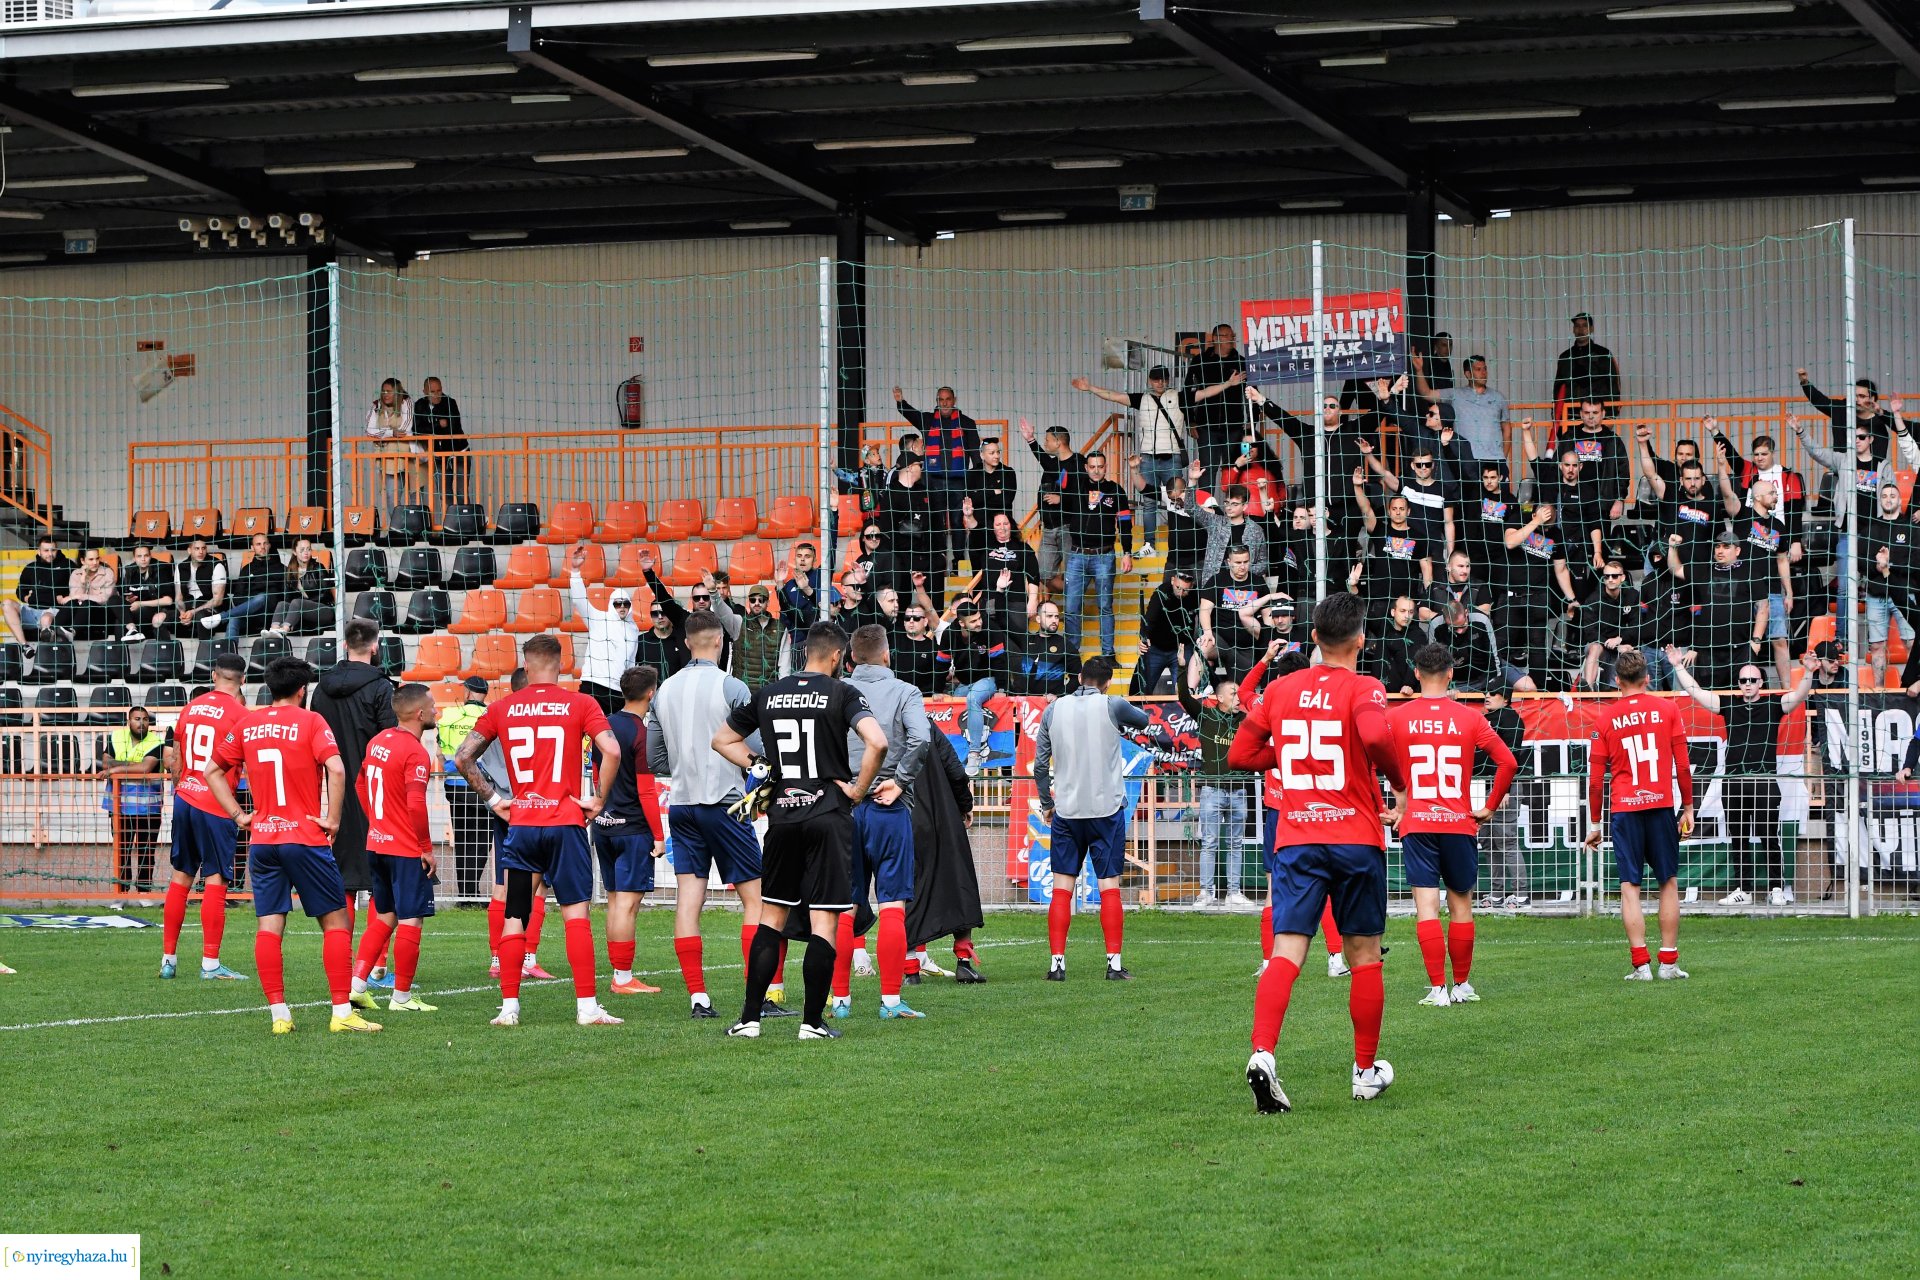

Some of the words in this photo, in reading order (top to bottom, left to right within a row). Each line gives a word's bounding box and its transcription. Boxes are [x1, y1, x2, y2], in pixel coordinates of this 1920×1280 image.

[1249, 354, 1396, 373] NYÍREYHÁZA
[188, 704, 225, 720] BRESÓ
[507, 702, 571, 718] ADAMCSEK
[766, 691, 829, 710] HEGEDÜS
[1298, 688, 1333, 710] GÁL
[1611, 711, 1647, 731] NAGY
[1651, 710, 1663, 724] B.
[185, 723, 216, 772] 19
[243, 723, 299, 743] SZERETŐ
[772, 719, 819, 779] 21
[1408, 719, 1443, 735] KISS
[1447, 717, 1462, 735] Á.
[1824, 708, 1920, 773] NA
[1861, 717, 1870, 767] 1995
[257, 748, 287, 807] 7
[508, 726, 565, 784] 27
[1281, 719, 1345, 791] 25
[1409, 744, 1463, 799] 26
[1621, 732, 1659, 786] 14
